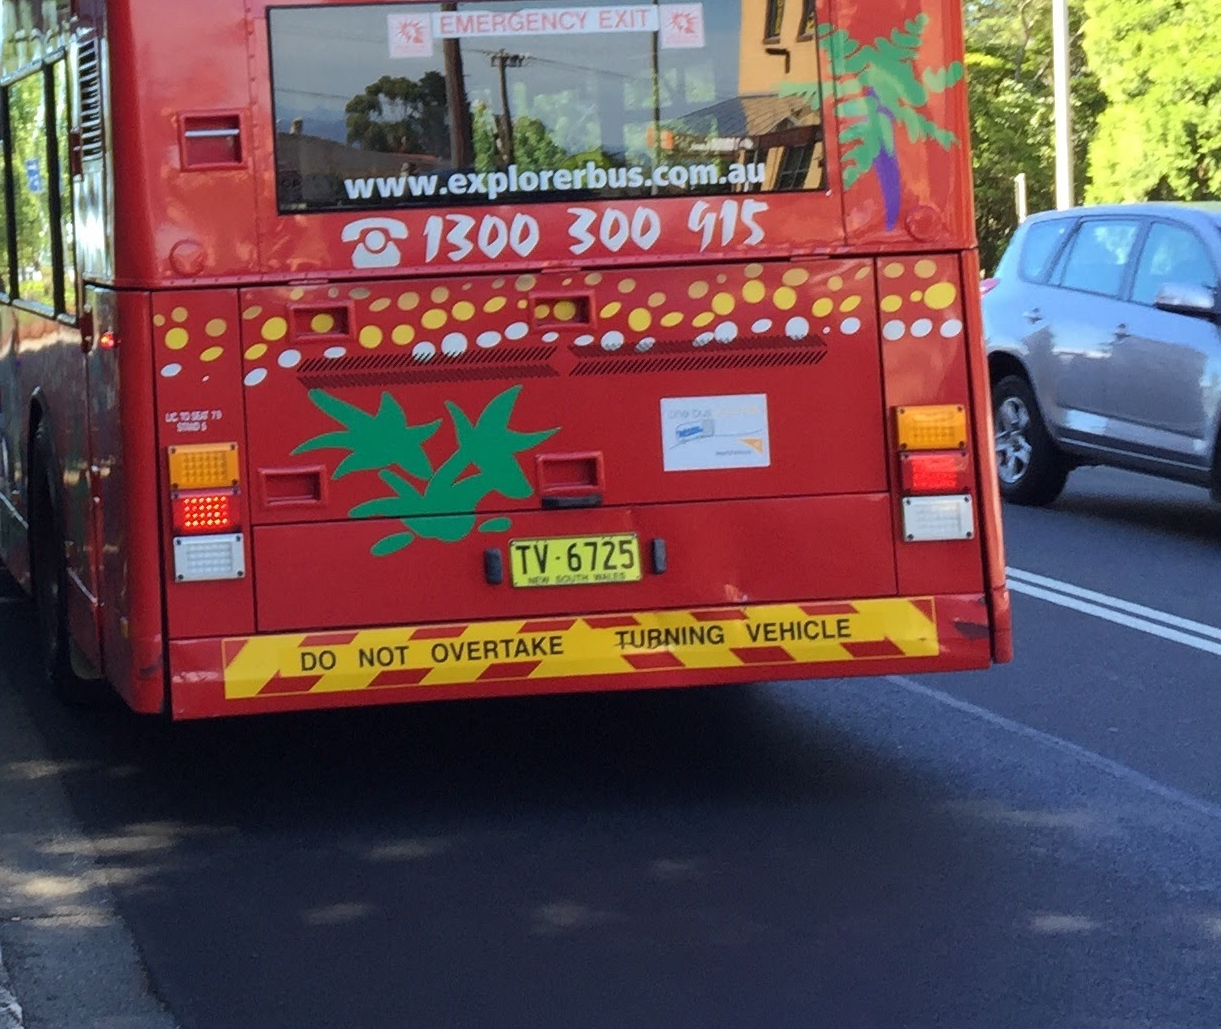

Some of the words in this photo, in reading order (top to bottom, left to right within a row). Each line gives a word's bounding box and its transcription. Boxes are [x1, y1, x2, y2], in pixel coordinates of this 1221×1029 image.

[439, 10, 588, 35] EMERGENCY
[598, 8, 649, 29] EXIT
[343, 160, 767, 200] www.explorerbus.com.au
[423, 212, 540, 263] 1300
[567, 206, 661, 255] 300
[687, 198, 769, 252] 915
[555, 574, 588, 583] SOUTH
[300, 650, 337, 672] DO
[358, 645, 409, 668] NOT
[431, 635, 564, 664] OVERTAKE
[615, 624, 725, 650] TURNING
[746, 619, 851, 643] VEHICLE
